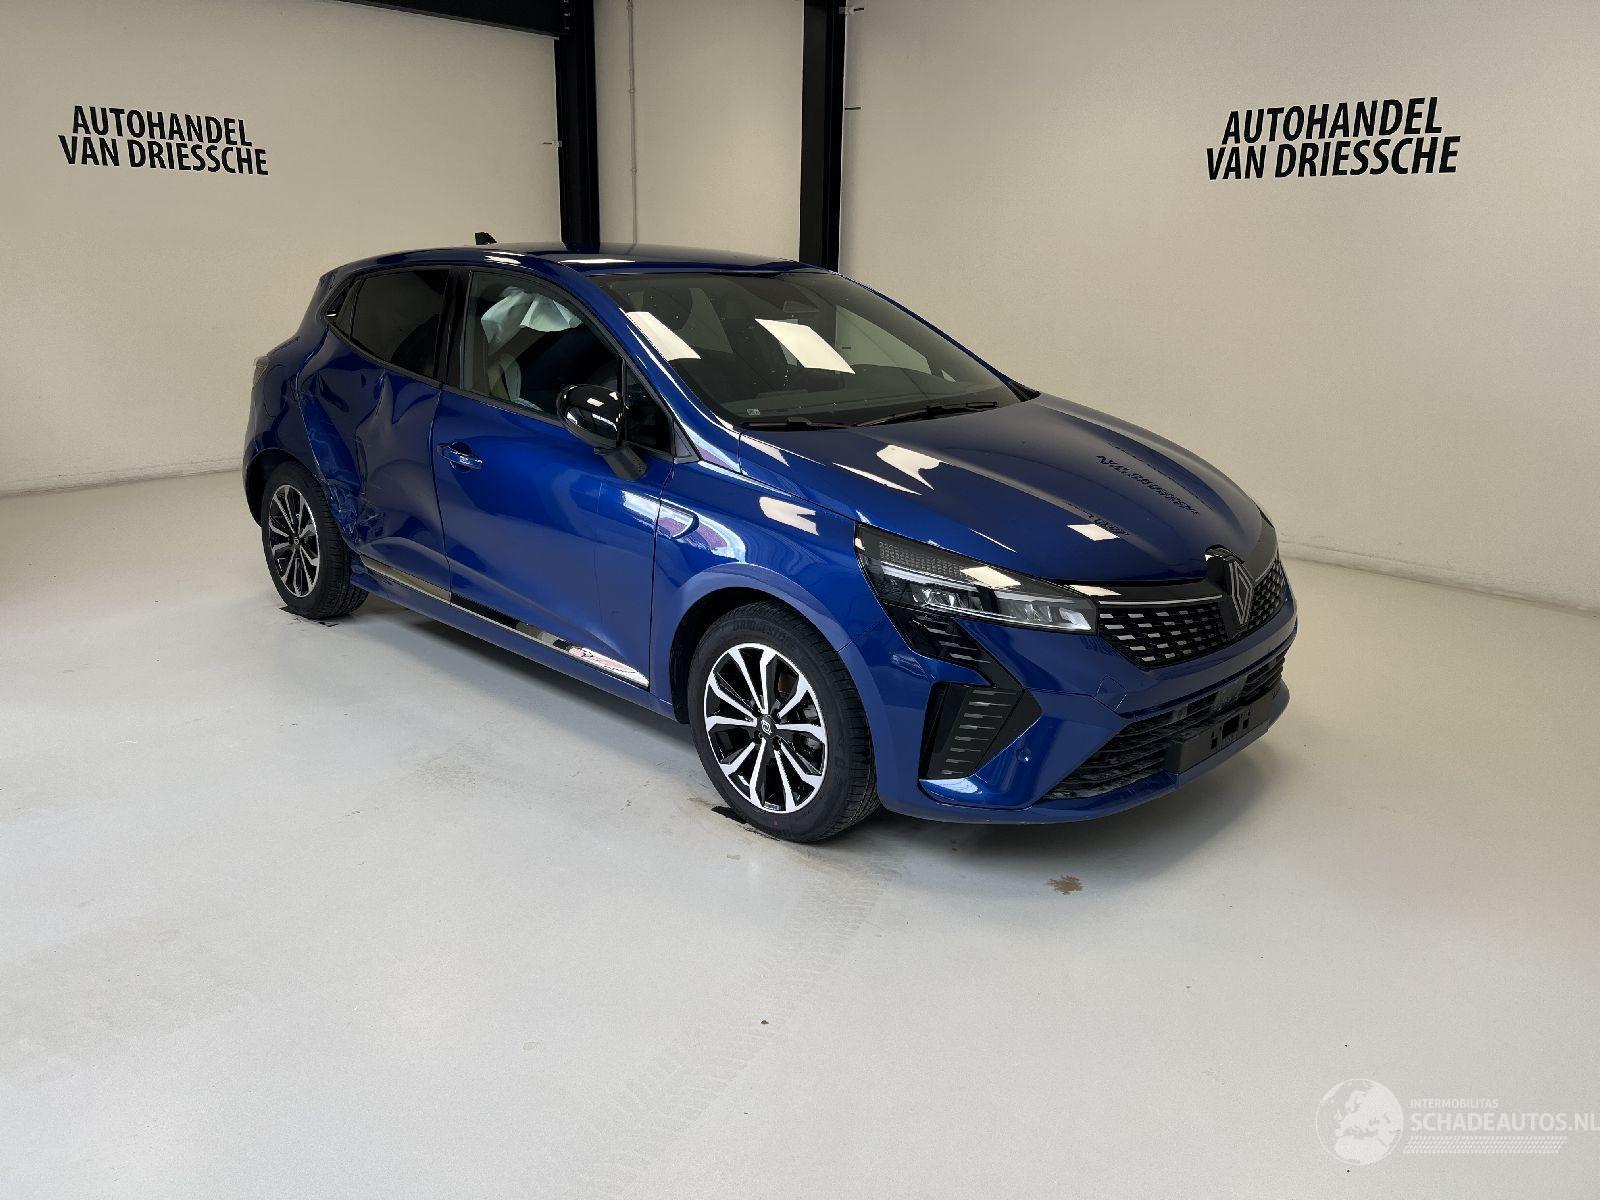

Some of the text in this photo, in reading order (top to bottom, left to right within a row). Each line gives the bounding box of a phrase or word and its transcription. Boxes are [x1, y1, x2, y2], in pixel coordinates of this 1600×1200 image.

[72, 105, 252, 146] AUTOHANDEL
[1221, 96, 1443, 145] AUTOHANDEL
[58, 134, 269, 175] VAN DRIESSCHE
[1206, 135, 1461, 181] VAN DRIESSCHE
